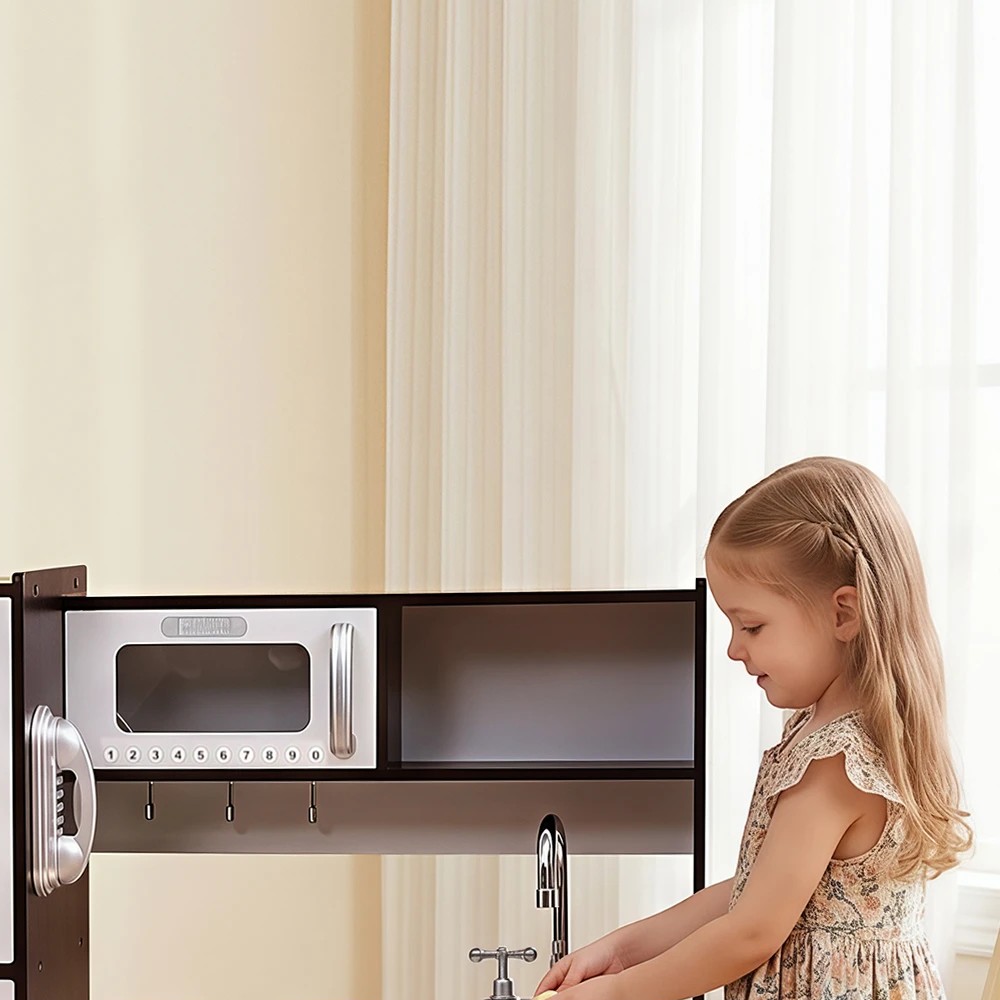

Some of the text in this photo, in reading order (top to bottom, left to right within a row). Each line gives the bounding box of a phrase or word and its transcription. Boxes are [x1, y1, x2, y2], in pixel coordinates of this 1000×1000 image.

[108, 750, 320, 760] 1 2 3 4 5 6 7 8 9 0
